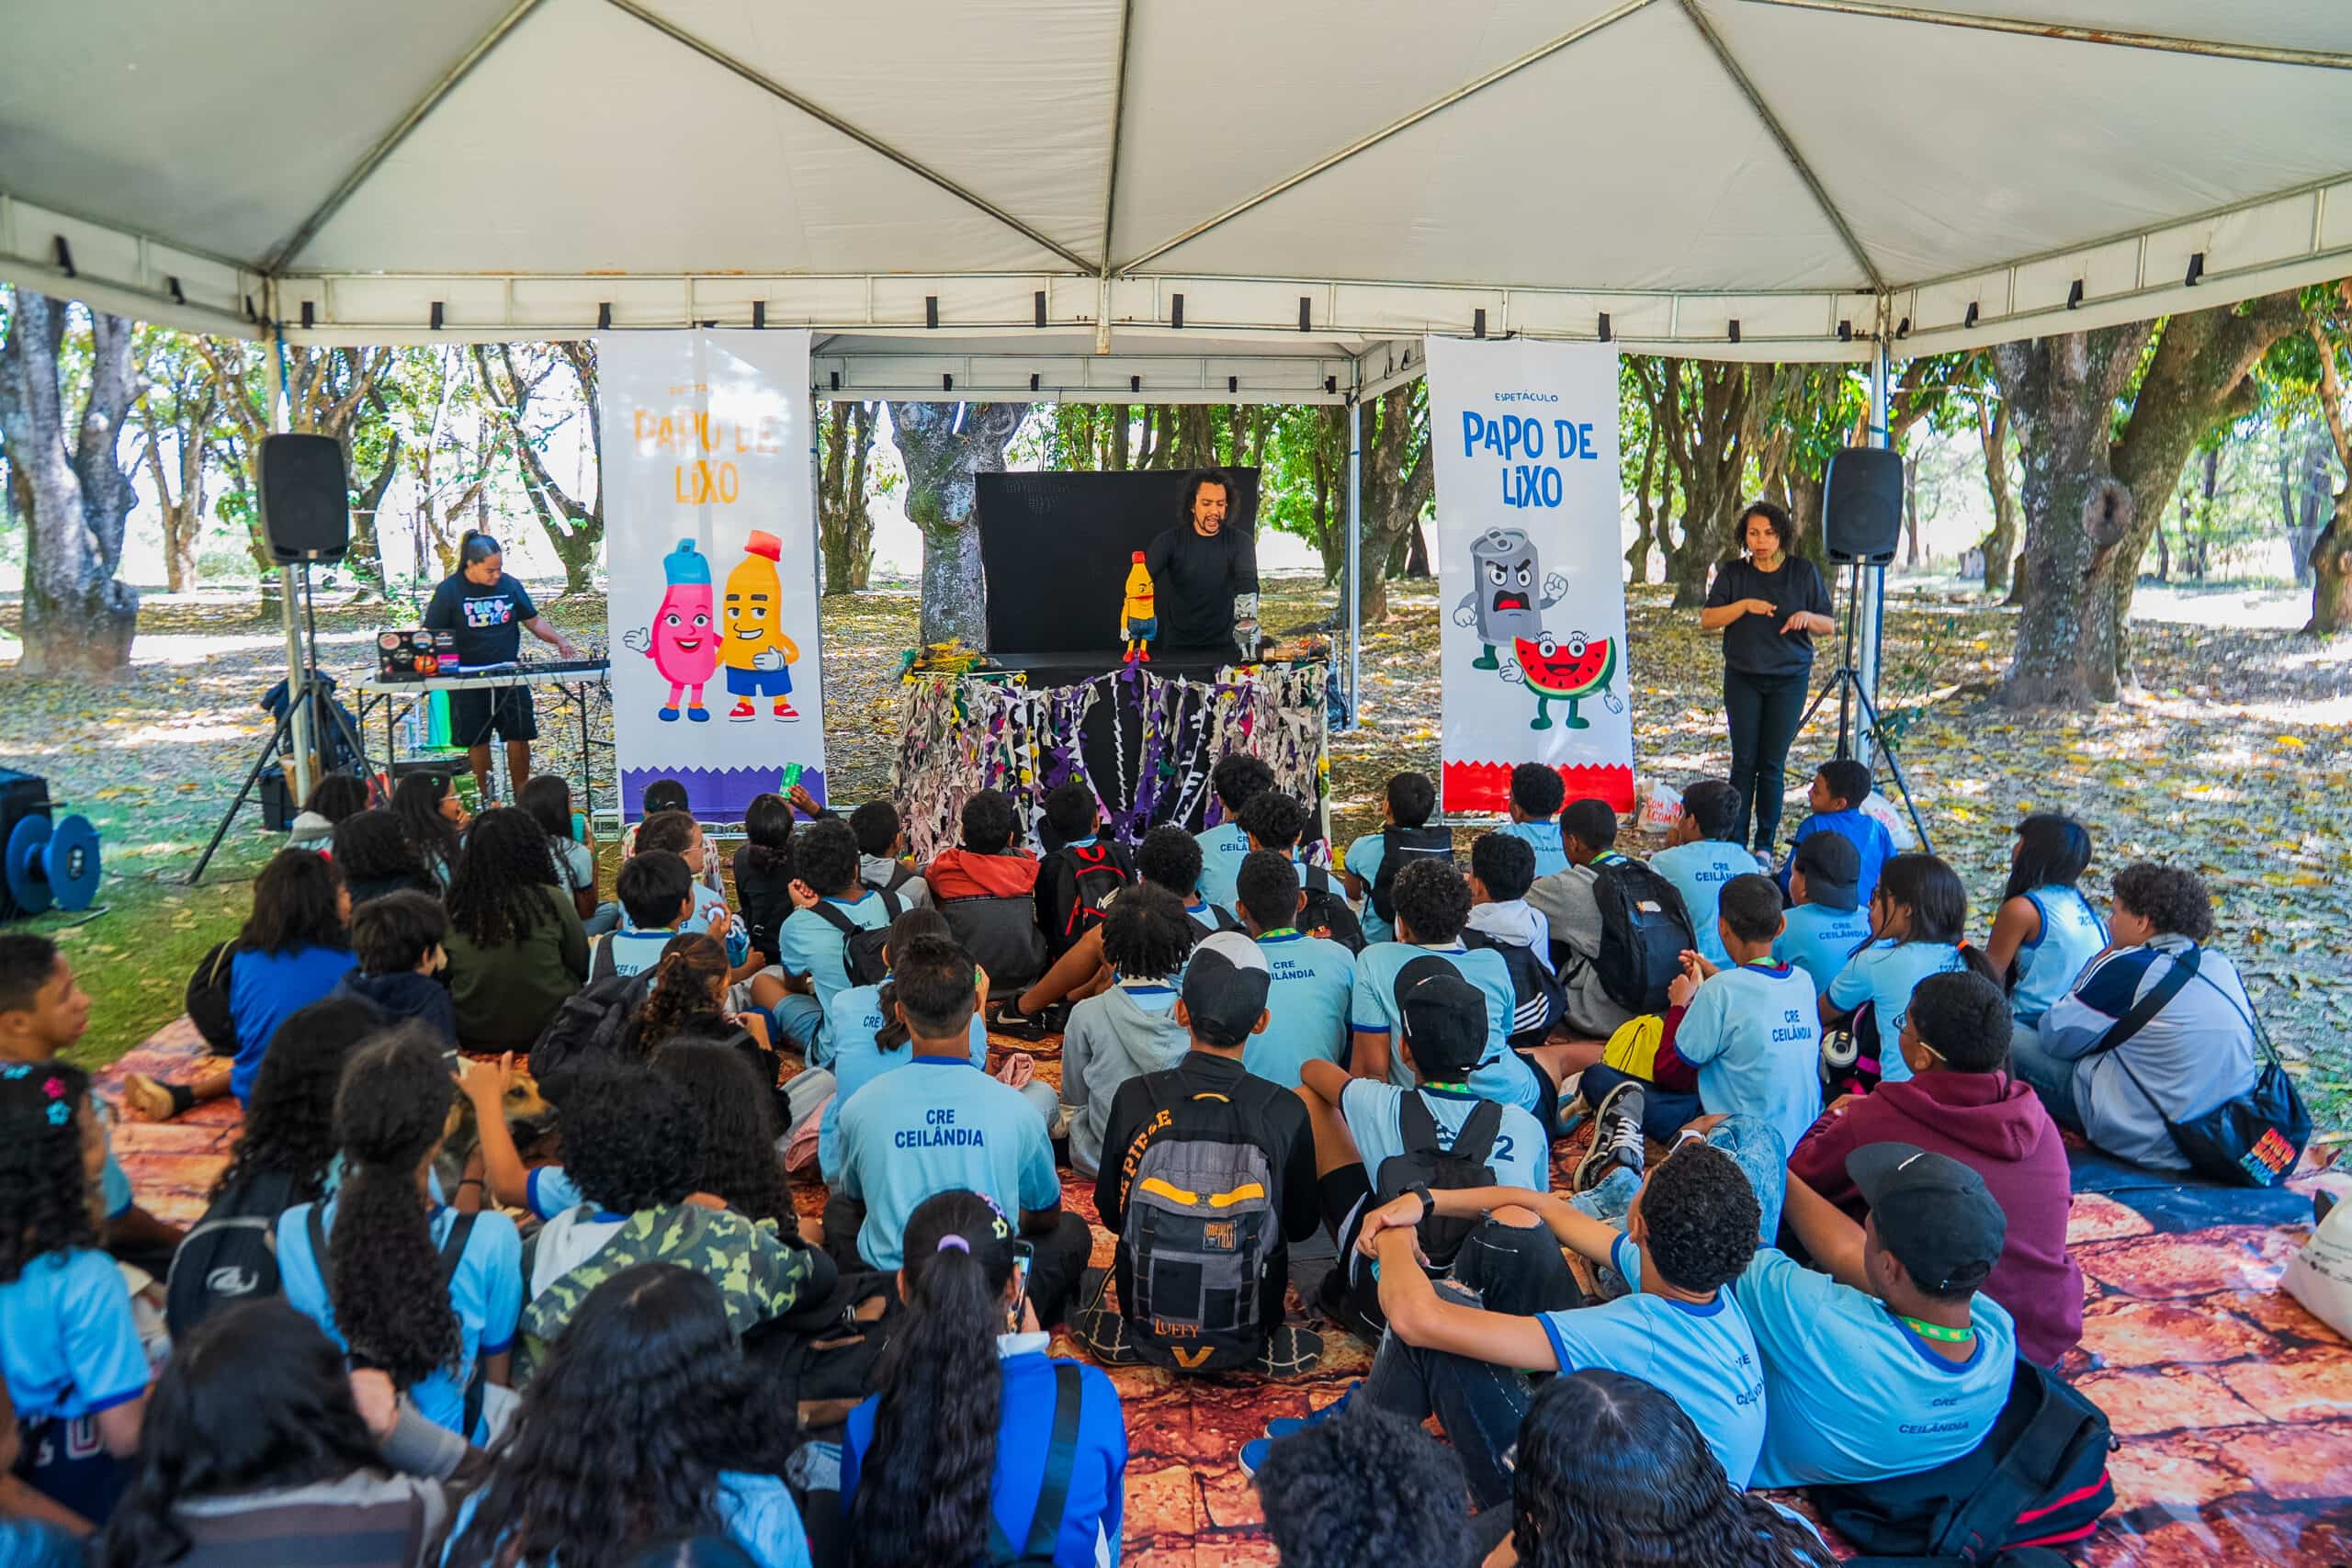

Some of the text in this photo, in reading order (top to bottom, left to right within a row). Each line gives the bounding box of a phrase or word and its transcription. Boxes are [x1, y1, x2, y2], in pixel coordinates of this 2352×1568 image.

[1495, 389, 1558, 402] ESPETÁCULO
[1463, 411, 1598, 461] PAPO DE
[1220, 842, 1248, 852] CEILÂ
[1272, 959, 1295, 970] CRE
[1272, 968, 1316, 980] ILÂNDIA
[864, 1015, 881, 1028] CRE
[1784, 1010, 1801, 1023] CRE
[1772, 1024, 1812, 1043] CEILÂNDIA
[926, 1109, 956, 1125] CRE
[895, 1125, 984, 1148] CEILÂNDIA
